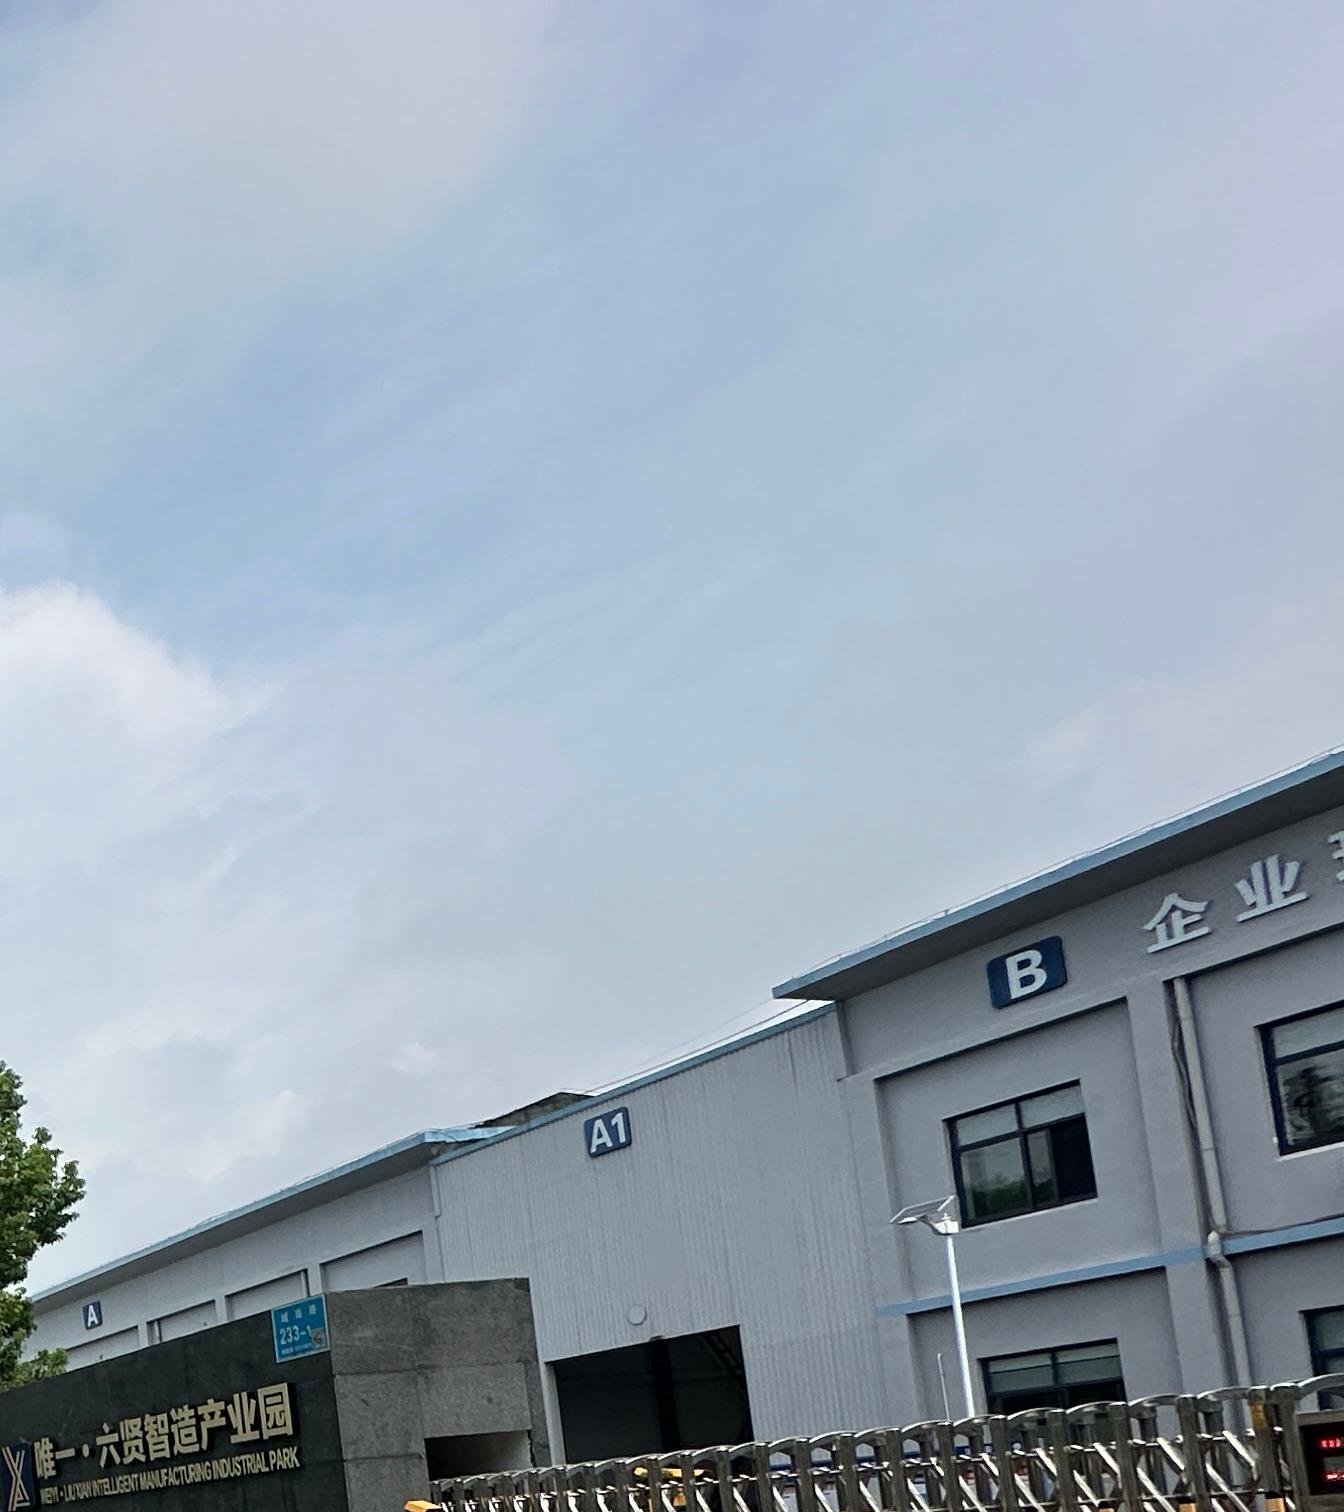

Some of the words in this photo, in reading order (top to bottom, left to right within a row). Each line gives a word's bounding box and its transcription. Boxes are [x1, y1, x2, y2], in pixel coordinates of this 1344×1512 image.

[1006, 950, 1047, 999] B
[591, 1112, 626, 1153] A1
[87, 1305, 99, 1327] A
[34, 1382, 293, 1479] 唯一·六贤智造产业园
[92, 1474, 139, 1498] INTELLIGENT
[140, 1461, 212, 1491] MANUFACTURING
[212, 1451, 269, 1480] INDUSTRIAL
[269, 1446, 300, 1471] PARK
